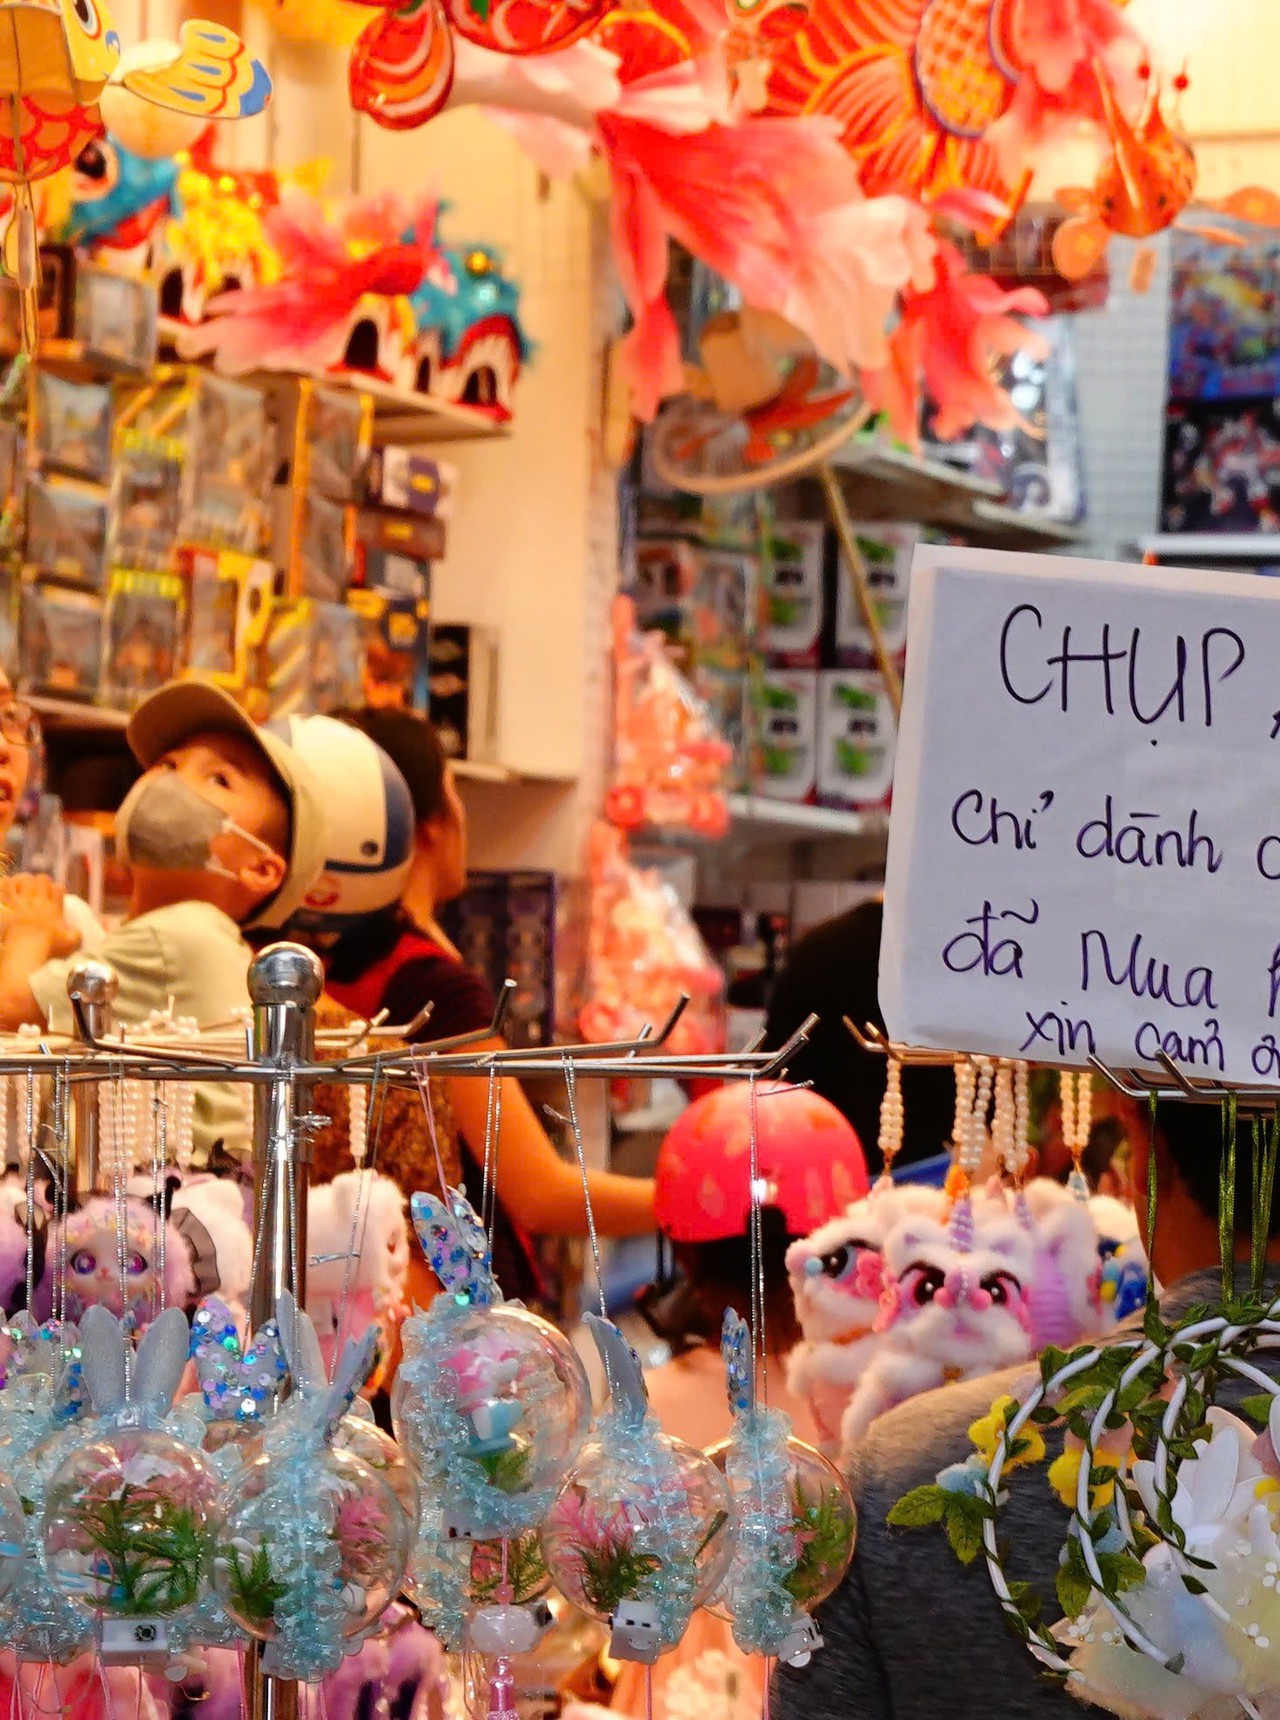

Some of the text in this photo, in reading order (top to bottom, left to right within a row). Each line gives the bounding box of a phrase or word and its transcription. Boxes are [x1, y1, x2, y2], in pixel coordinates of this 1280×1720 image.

[1000, 603, 1245, 747] CHỤP
[942, 898, 1040, 980] đã
[1019, 1001, 1097, 1056] xin
